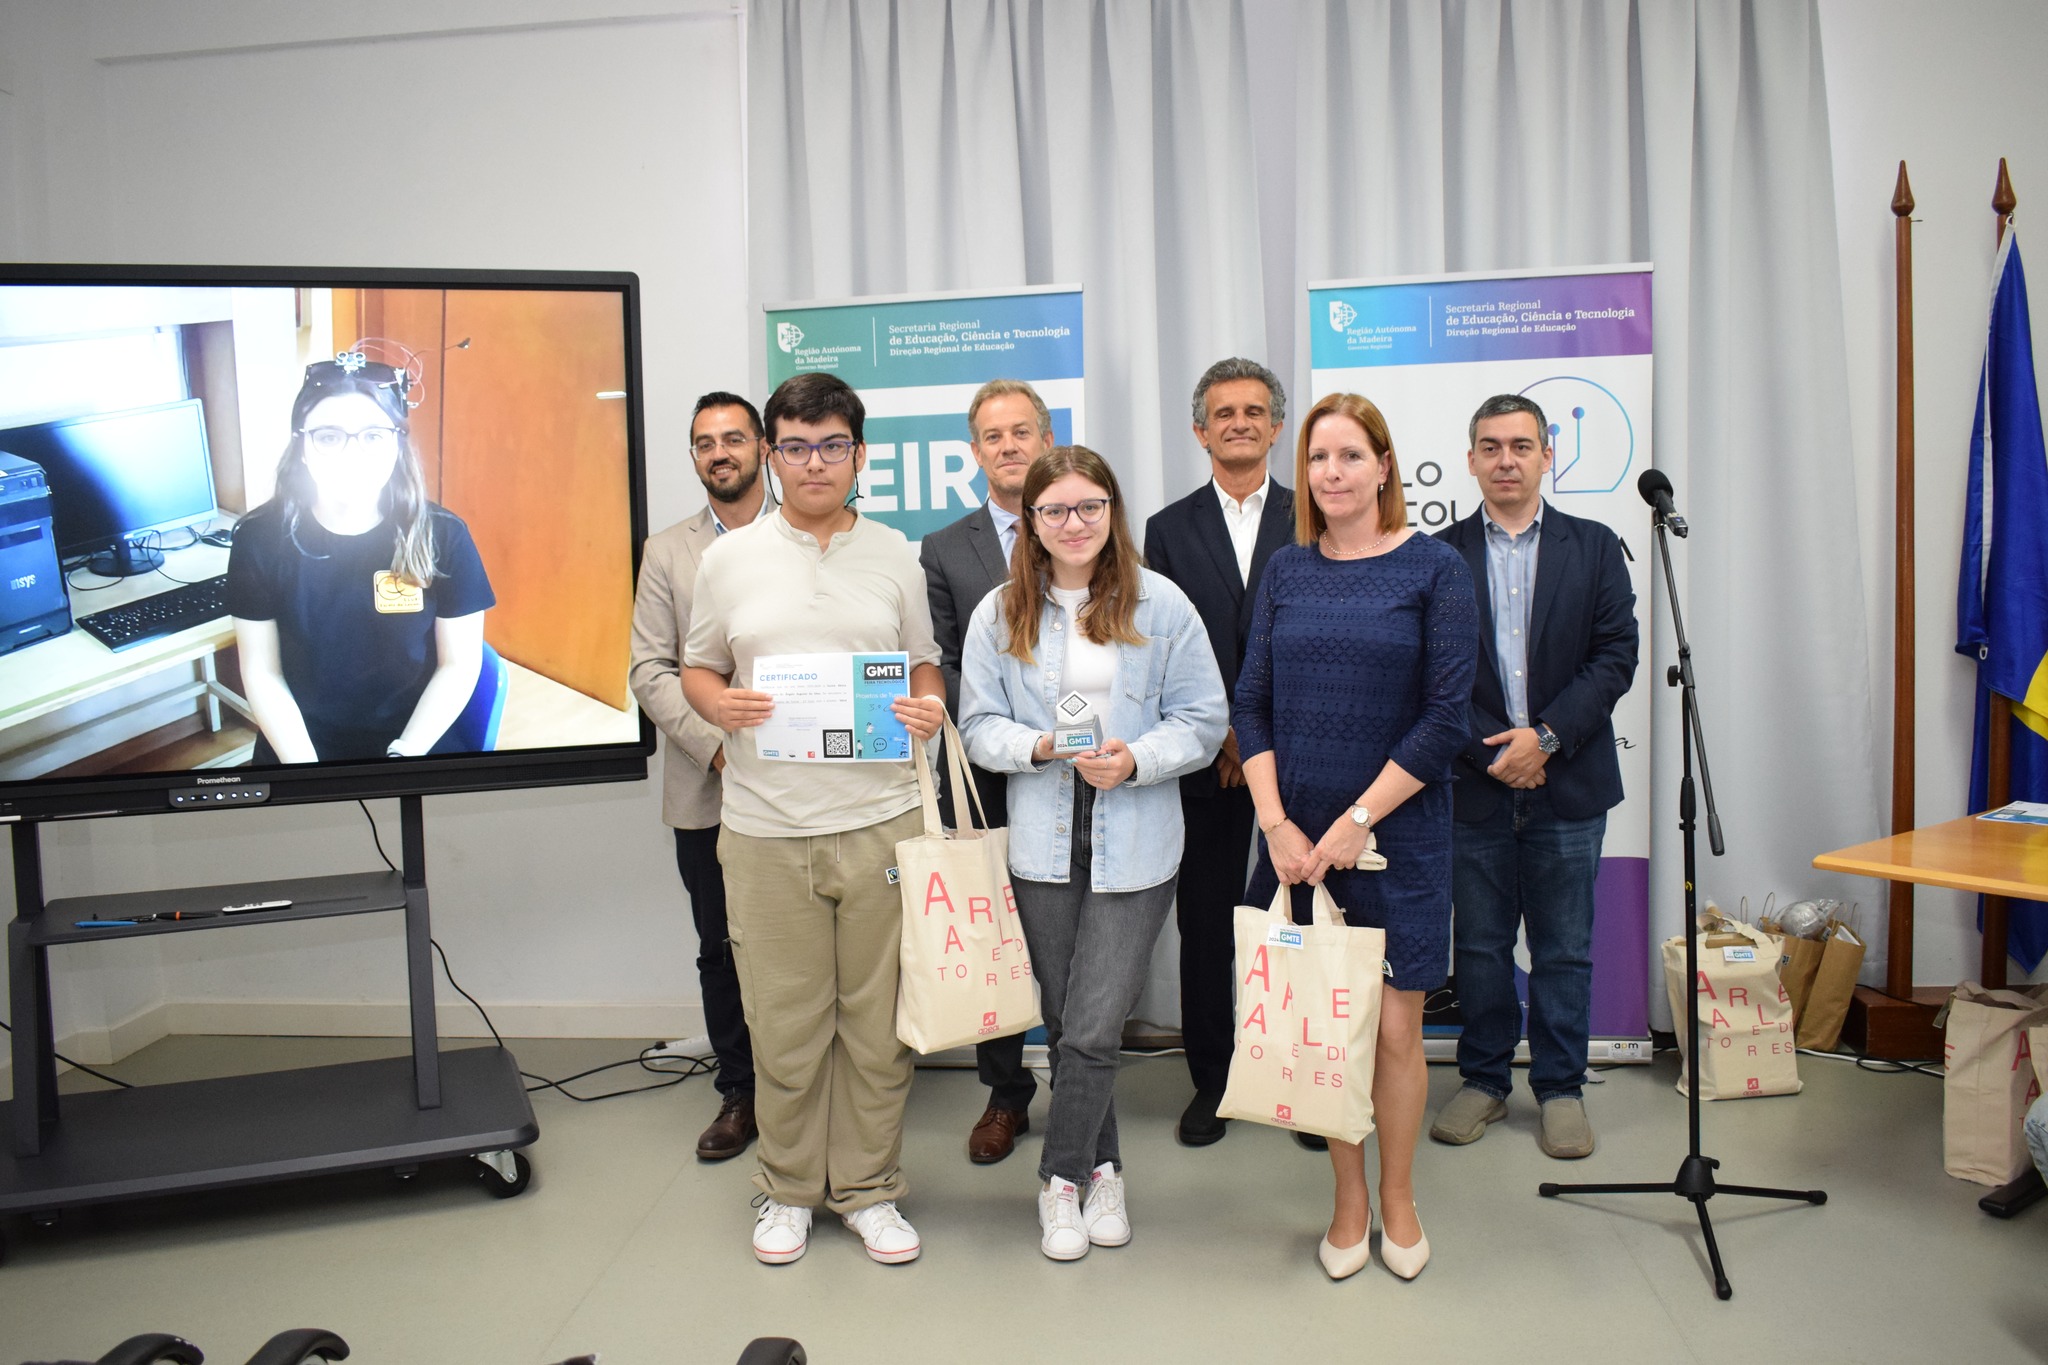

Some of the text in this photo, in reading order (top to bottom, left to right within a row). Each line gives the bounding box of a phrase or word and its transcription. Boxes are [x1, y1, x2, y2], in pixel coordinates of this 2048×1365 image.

[1445, 300, 1541, 314] Secretaria Regional
[1446, 307, 1635, 326] de Educação, Ciência e Tecnologia
[889, 320, 980, 334] Secretaria Regional
[1347, 325, 1416, 336] Região Autónoma
[1446, 323, 1576, 337] Direção Regional de Educação
[889, 326, 1070, 345] de Educação, Ciência e Tecnologia
[1347, 335, 1392, 344] da Madeira
[795, 345, 861, 357] Região Autónoma
[890, 342, 1015, 356] Direção Regional de Educação
[806, 355, 839, 363] Madeira
[856, 440, 982, 512] EIR
[866, 665, 902, 677] GMTE
[760, 673, 818, 682] CERTIFICADO
[1068, 736, 1091, 745] GMTE
[197, 776, 241, 784] Promethean
[1281, 933, 1300, 943] GMTE
